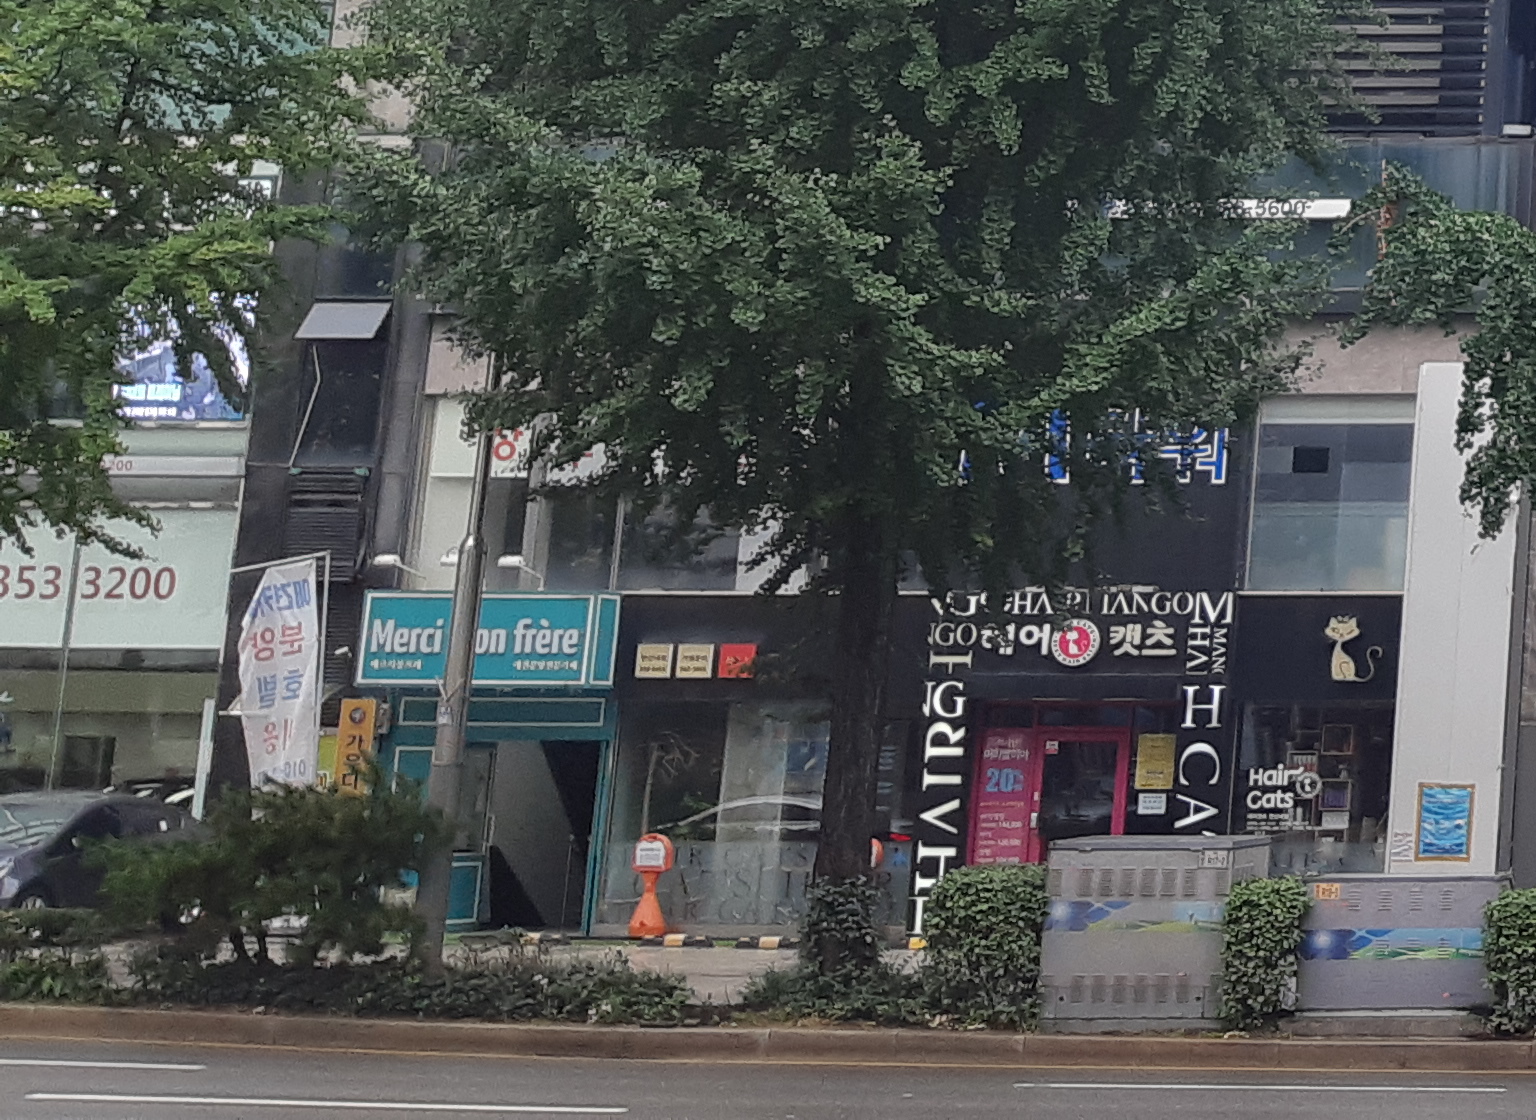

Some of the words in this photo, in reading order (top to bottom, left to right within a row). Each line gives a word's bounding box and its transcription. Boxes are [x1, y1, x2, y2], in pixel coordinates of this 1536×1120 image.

[80, 565, 177, 600] 3200
[370, 618, 446, 654] Merci
[513, 617, 579, 655] frère
[1109, 621, 1177, 657] 캣츠
[1249, 763, 1304, 787] Hair
[1246, 790, 1294, 809] Cats
